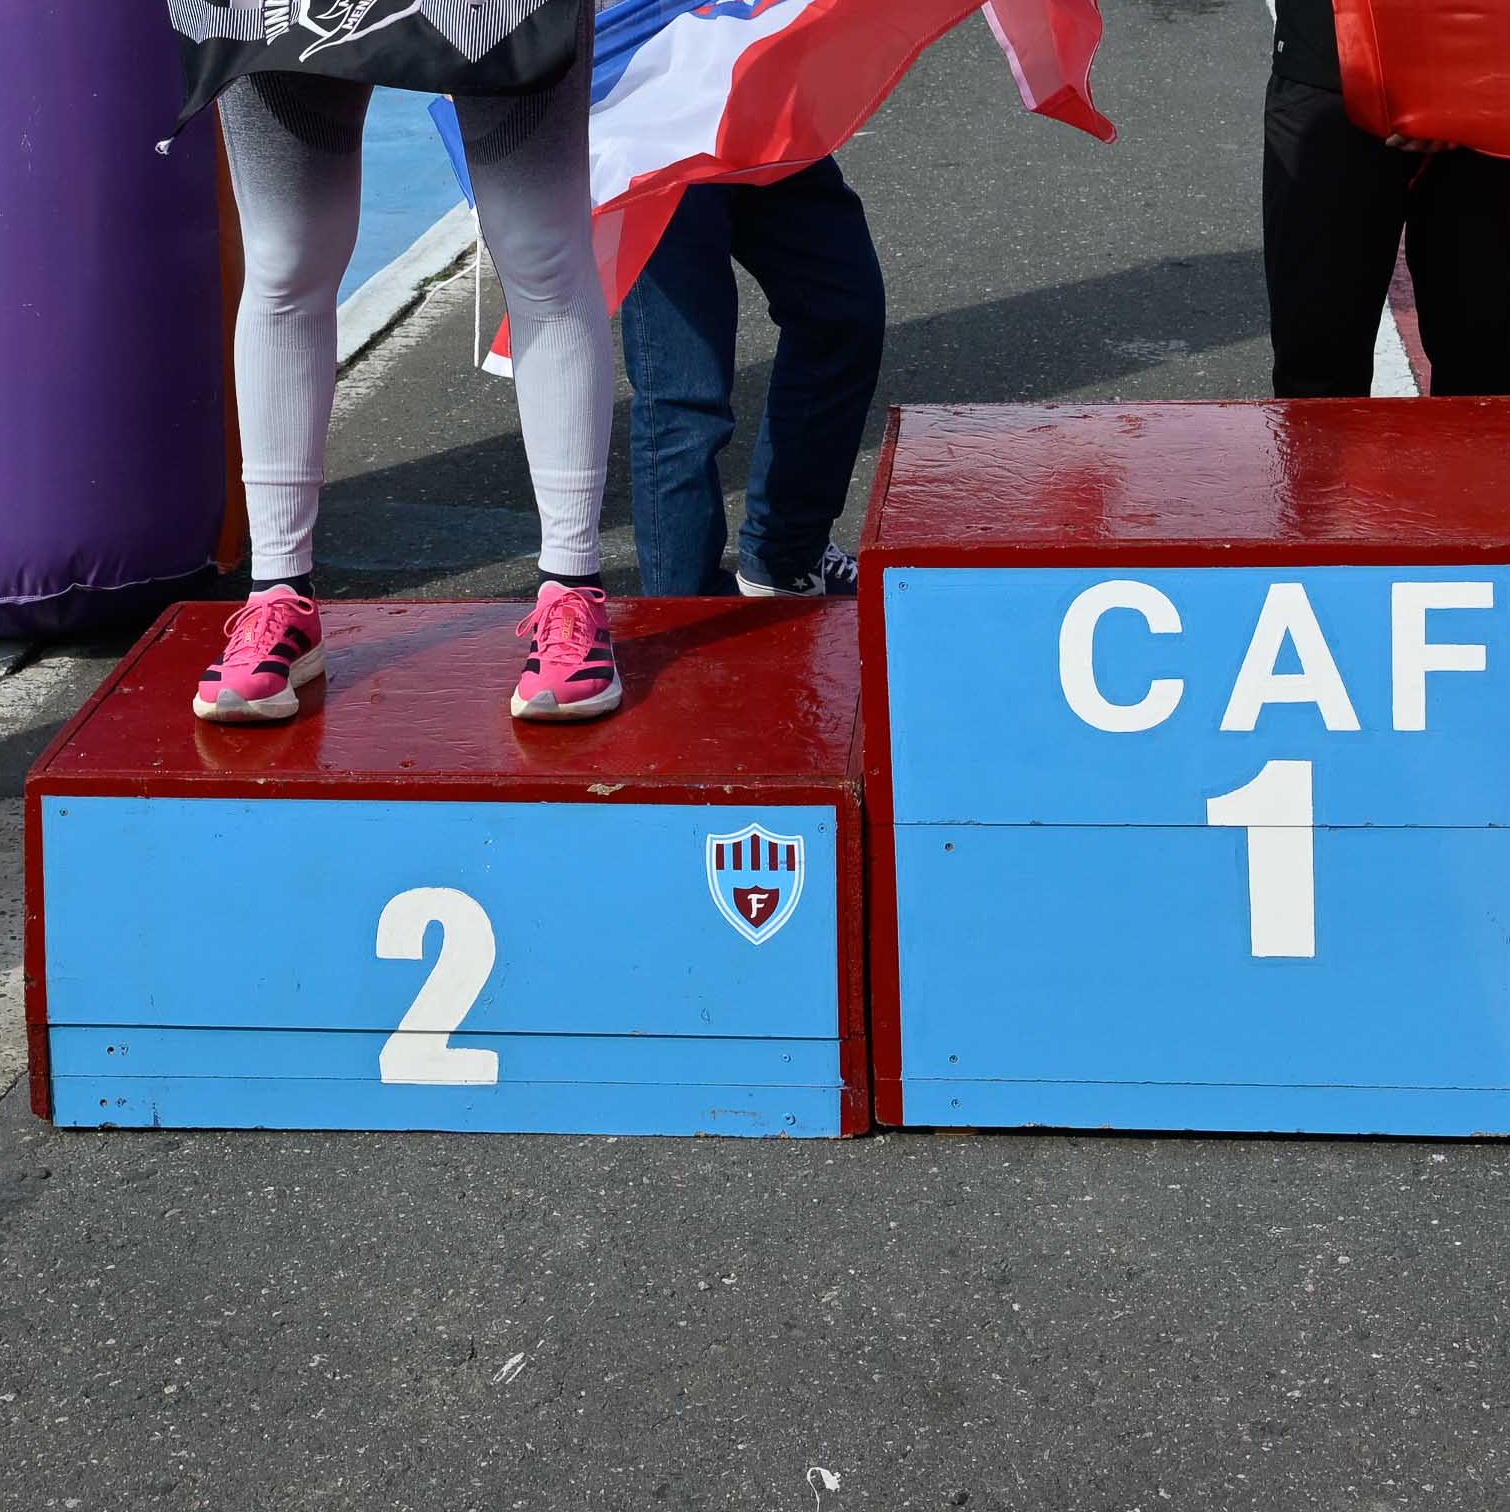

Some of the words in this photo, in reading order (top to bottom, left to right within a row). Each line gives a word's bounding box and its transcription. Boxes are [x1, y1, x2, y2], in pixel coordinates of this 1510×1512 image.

[1058, 579, 1494, 733] CAF
[1205, 760, 1316, 958] 1
[376, 886, 499, 1085] 2
